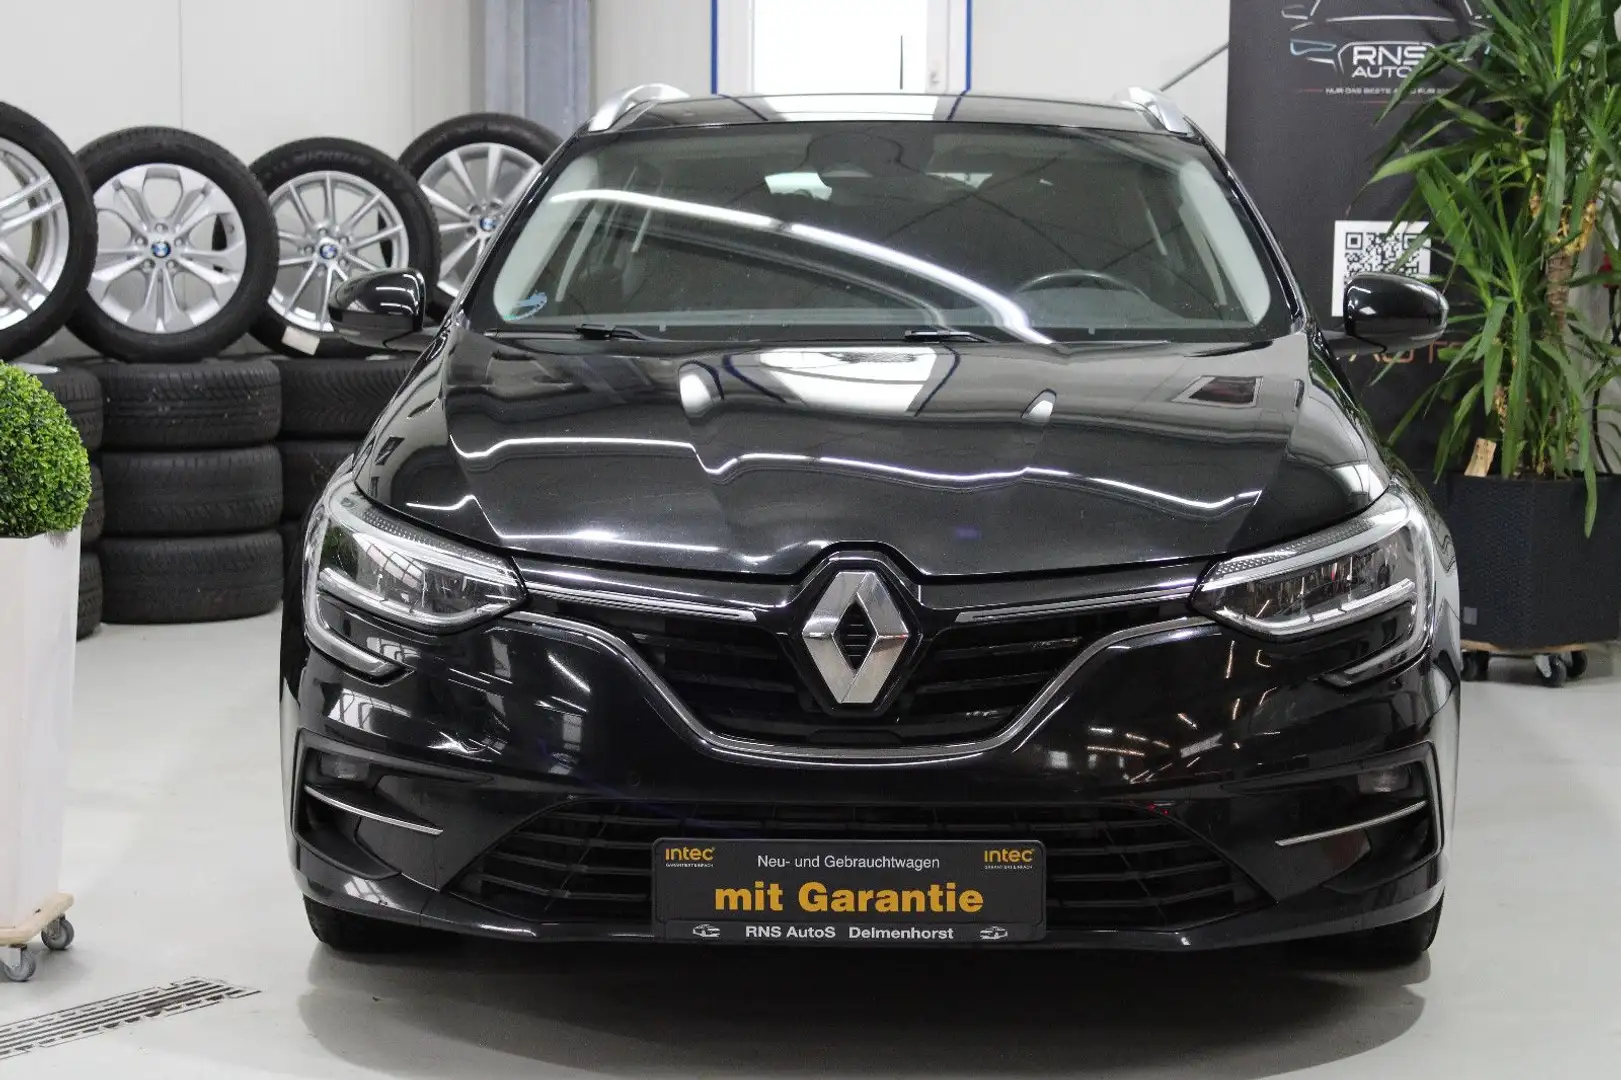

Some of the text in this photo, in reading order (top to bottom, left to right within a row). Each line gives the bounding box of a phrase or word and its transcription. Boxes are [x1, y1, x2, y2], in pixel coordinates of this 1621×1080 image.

[665, 846, 714, 861] intec
[984, 848, 1034, 863] intec
[757, 855, 940, 872] Neu- und Gebrauchtwagen
[715, 881, 984, 913] mit Garantie
[745, 926, 954, 940] RNS AutoS Delmenhorst
